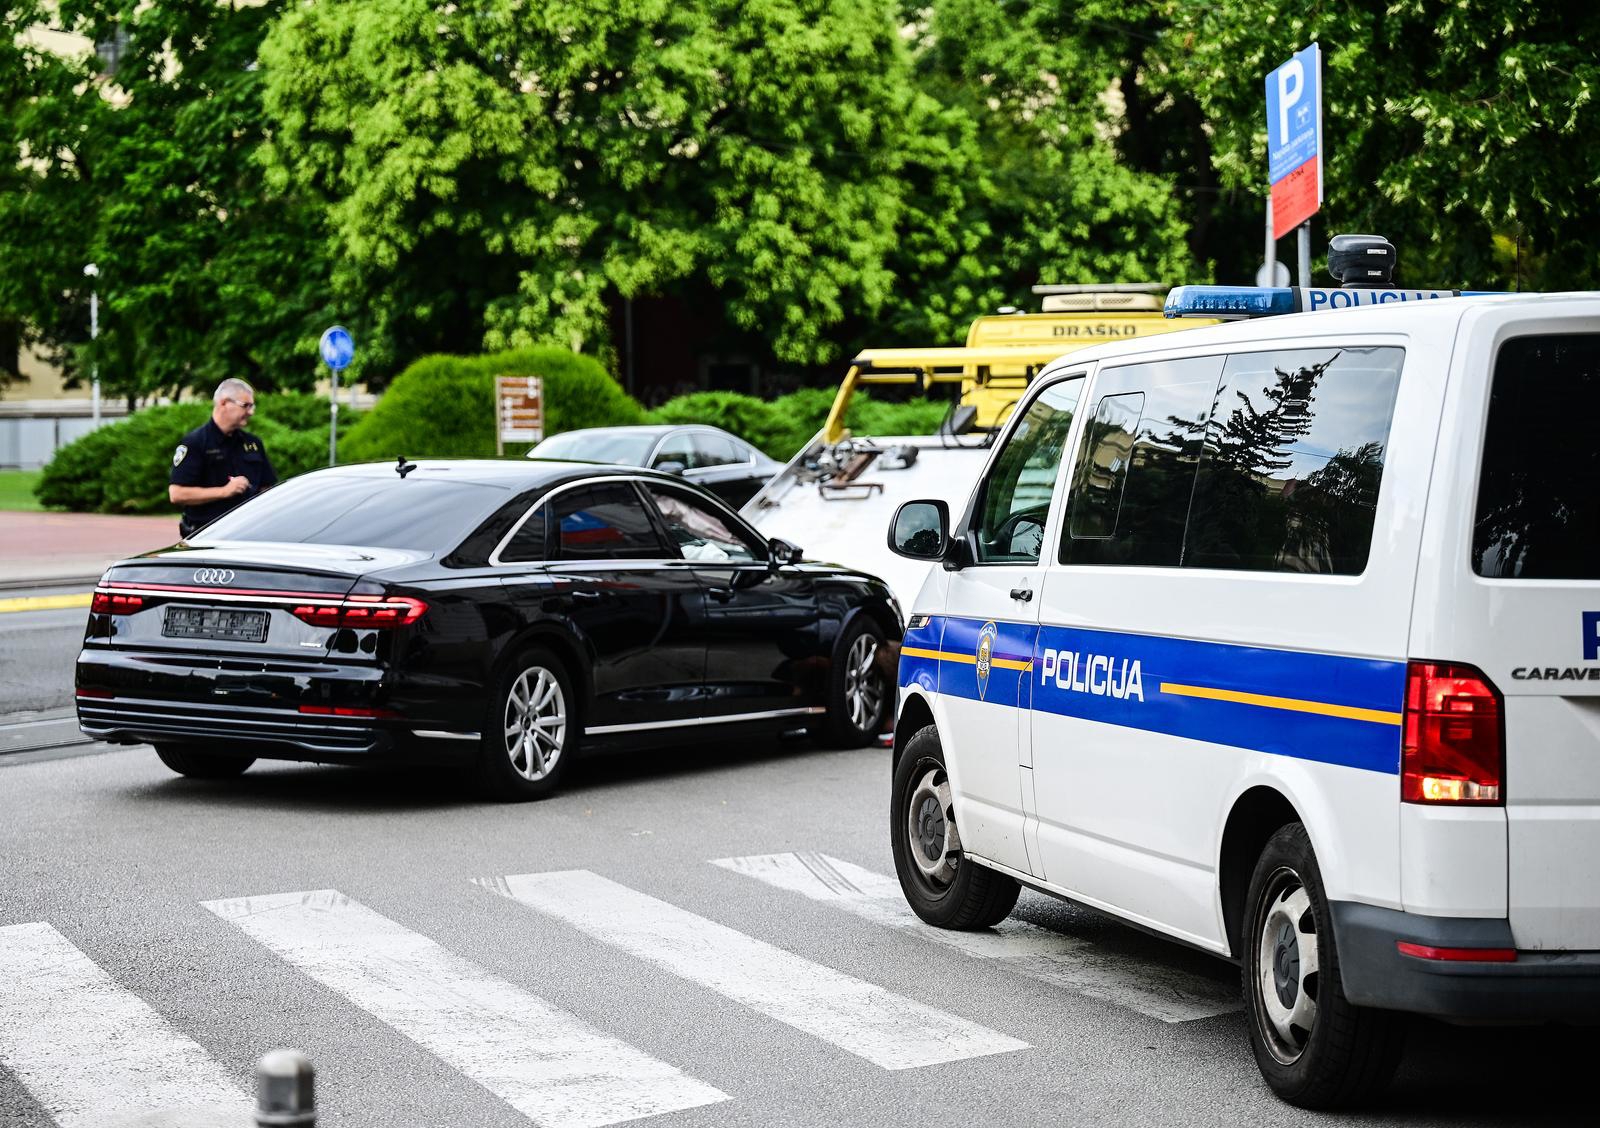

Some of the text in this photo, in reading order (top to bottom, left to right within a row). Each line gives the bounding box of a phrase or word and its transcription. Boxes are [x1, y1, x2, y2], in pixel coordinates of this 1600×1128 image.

[1278, 59, 1304, 146] P
[1309, 290, 1440, 312] POLIC
[1053, 323, 1136, 336] DRAŠKO
[1041, 648, 1145, 702] POLICIJA
